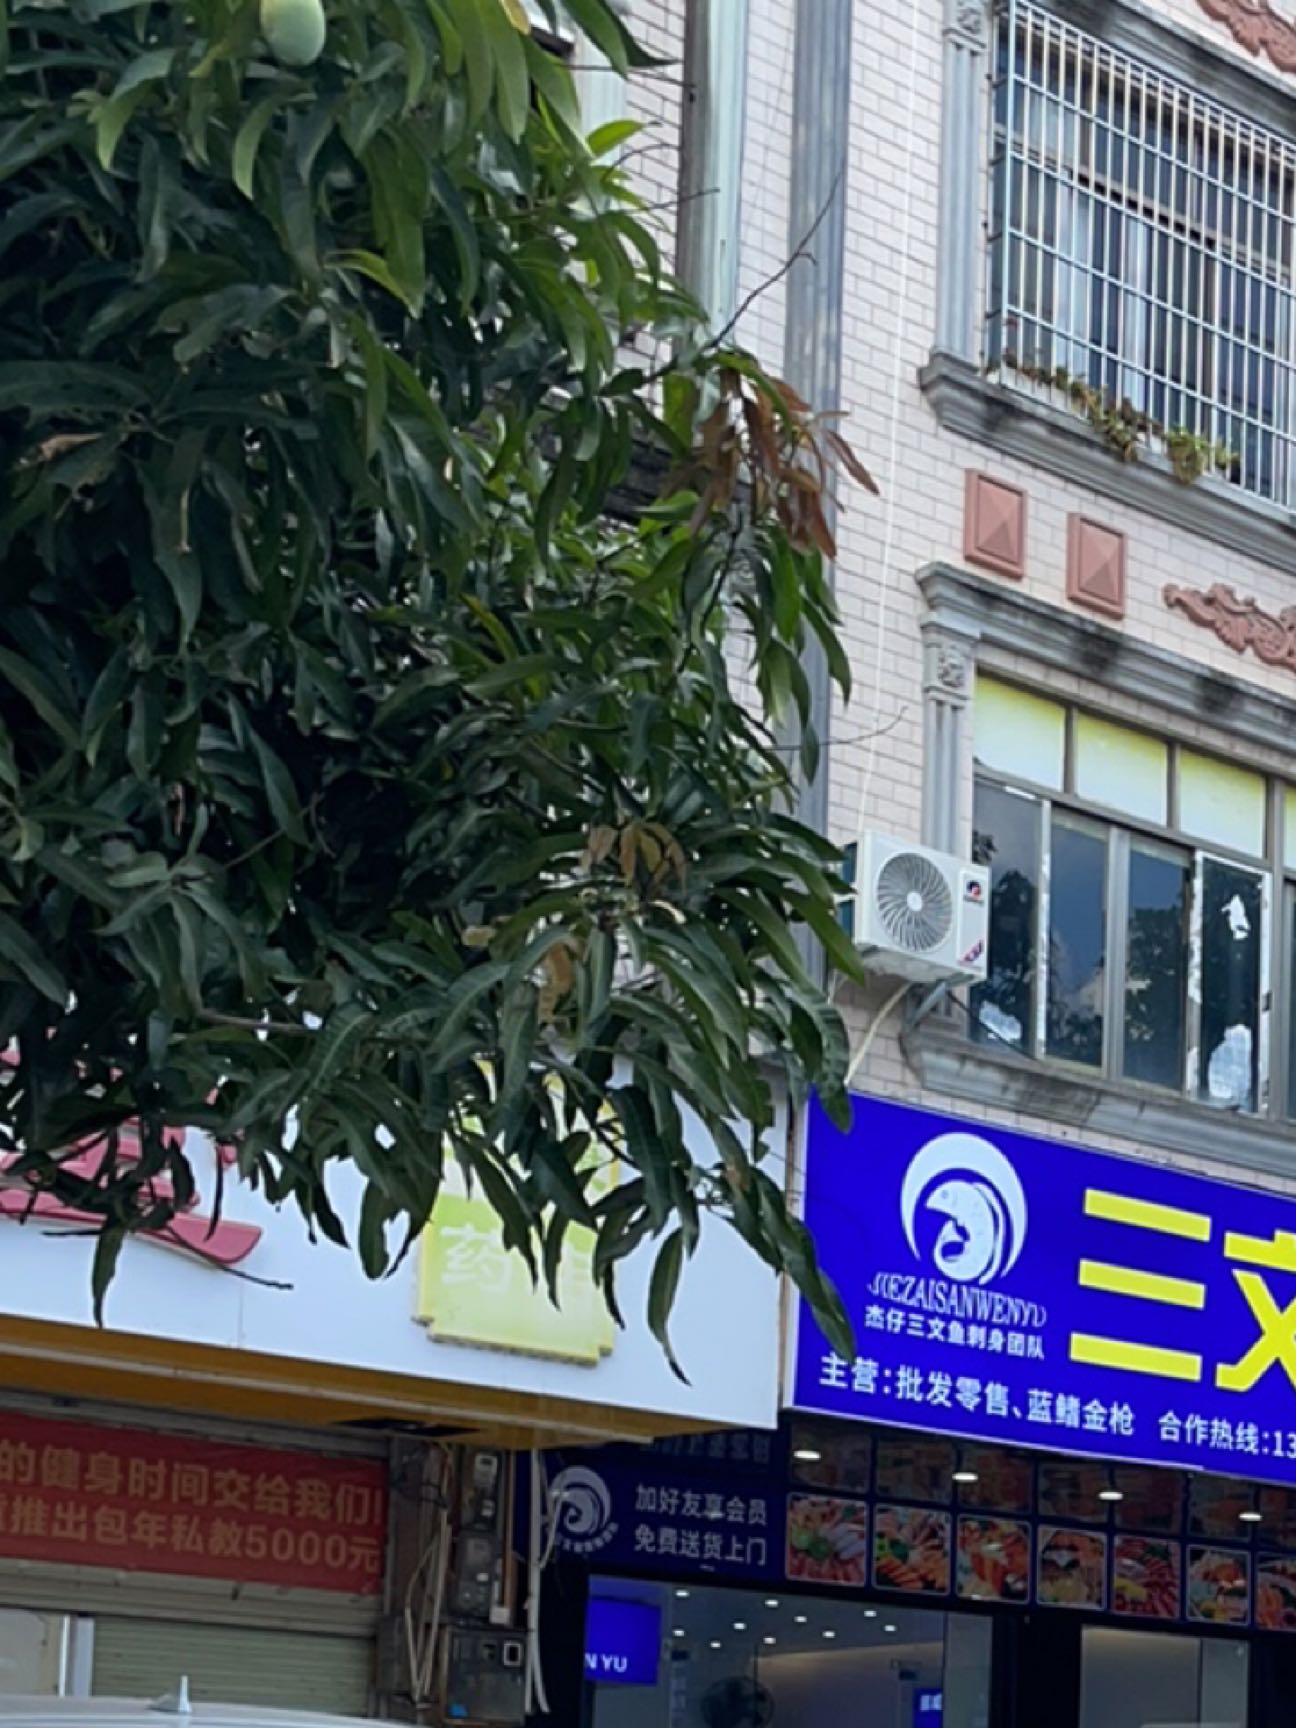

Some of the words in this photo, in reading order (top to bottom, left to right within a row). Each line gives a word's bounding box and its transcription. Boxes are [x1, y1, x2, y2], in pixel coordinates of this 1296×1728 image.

[0, 1492, 381, 1574] 推出包年私教5000元
